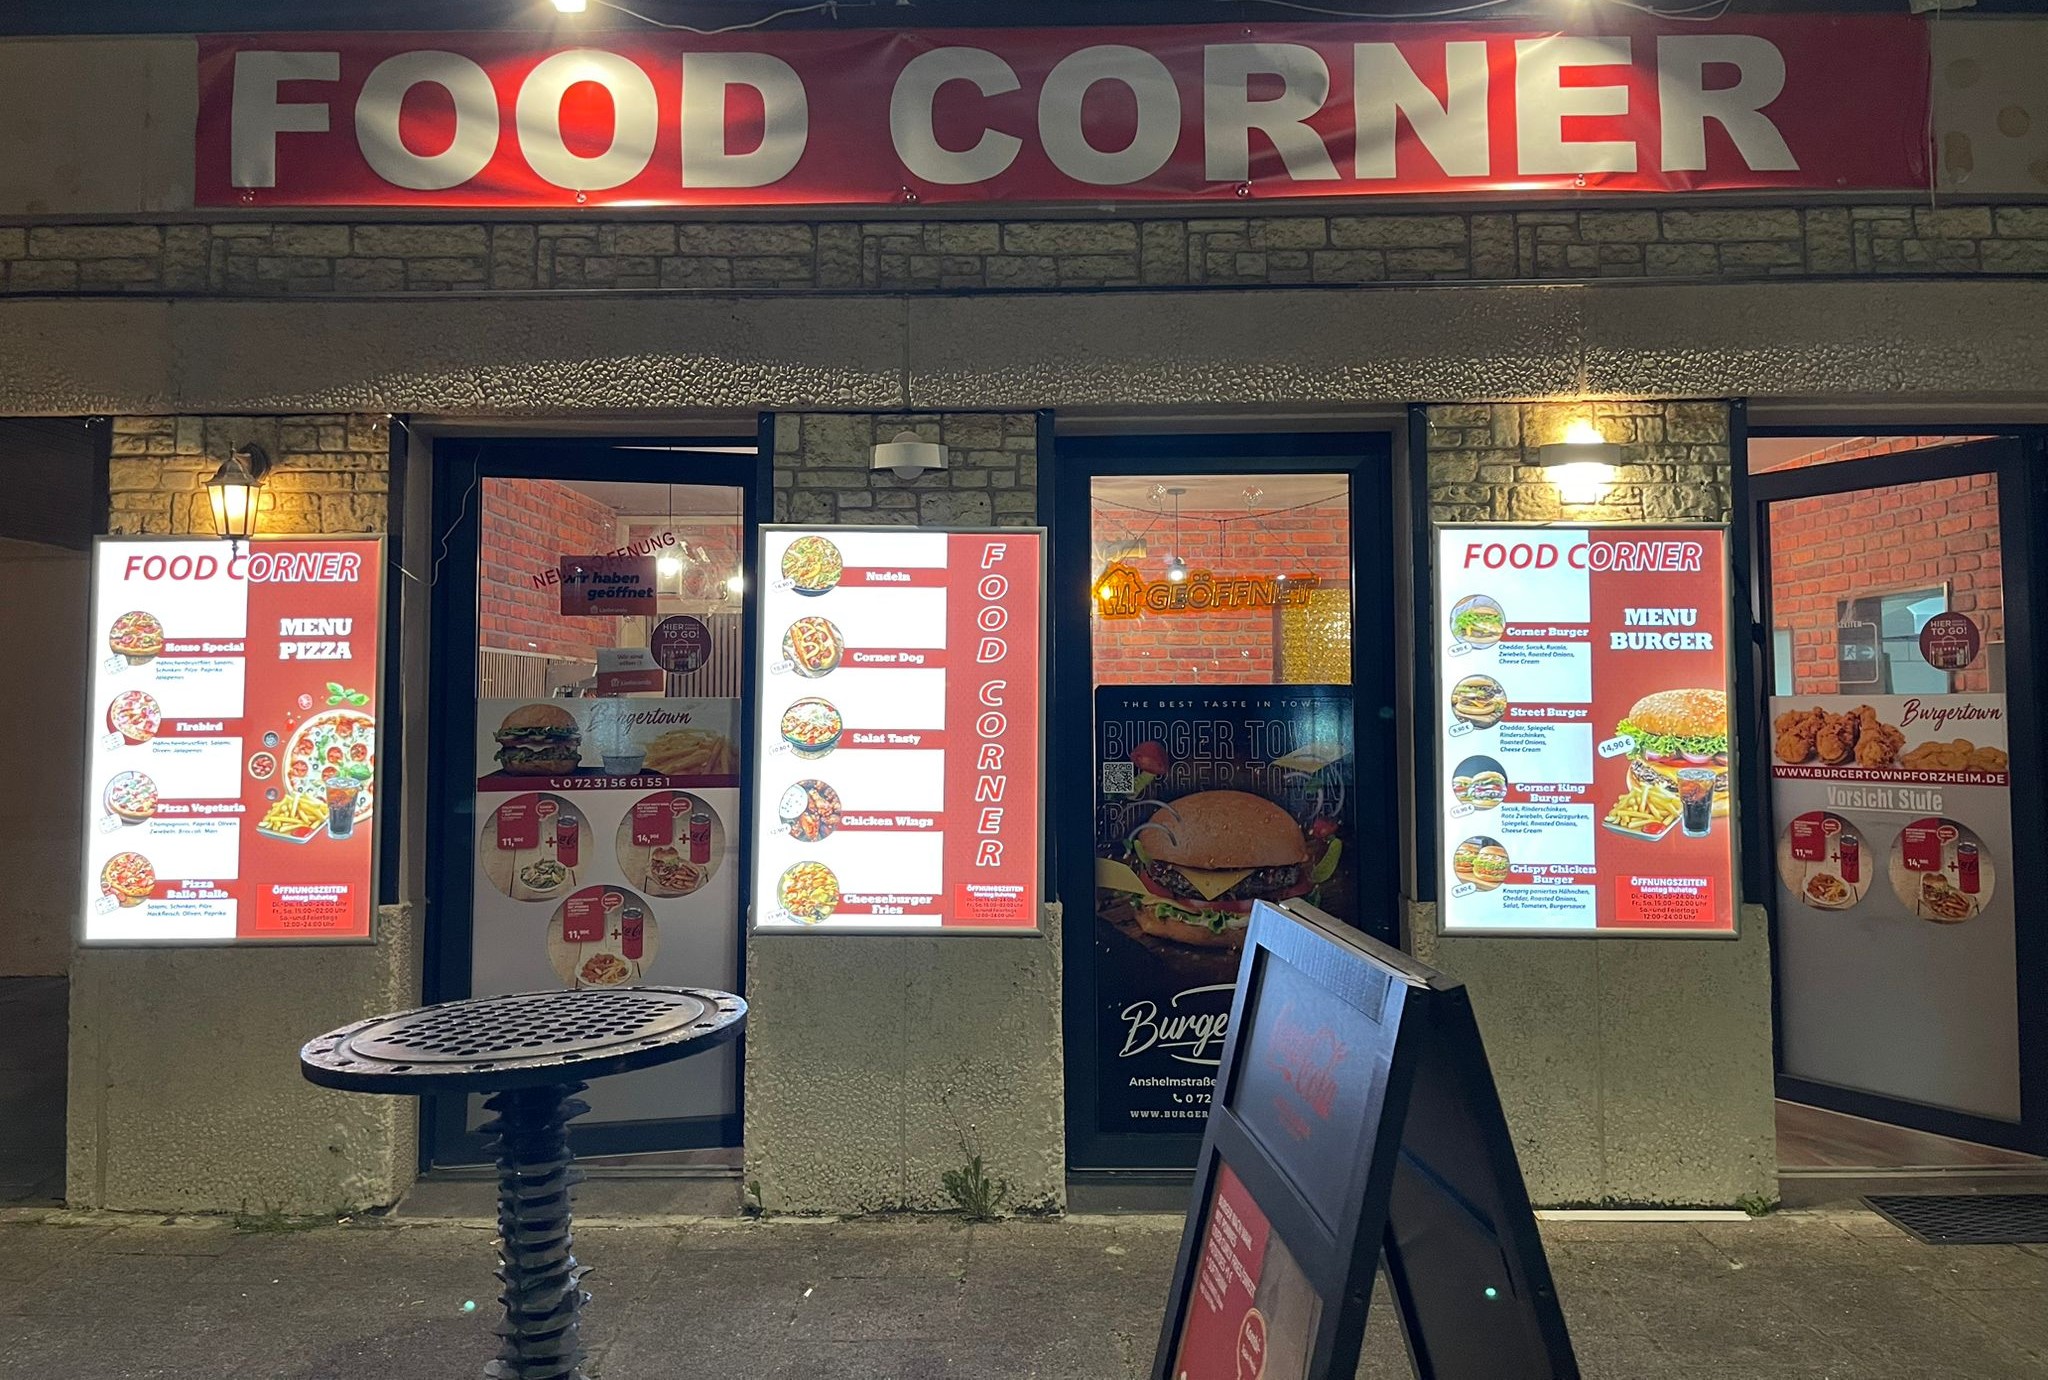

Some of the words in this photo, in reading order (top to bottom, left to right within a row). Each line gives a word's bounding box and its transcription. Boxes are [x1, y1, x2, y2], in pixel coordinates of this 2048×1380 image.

[231, 50, 808, 191] FOOD
[889, 34, 1801, 187] CORNER
[1463, 542, 1559, 570] FOOD
[1567, 541, 1703, 572] CORNER
[124, 555, 218, 581] FOOD
[227, 552, 361, 582] CORNER
[592, 572, 640, 583] haben
[865, 572, 911, 581] Nudeln
[587, 587, 654, 601] geöffnet
[1146, 573, 1315, 610] GEÖFFNET
[976, 542, 1009, 664] FOOD
[1624, 608, 1697, 626] MENU
[279, 617, 352, 636] MENU
[1948, 627, 1967, 635] GO!
[664, 630, 678, 639] TO
[680, 630, 699, 639] GO!
[1506, 627, 1547, 637] Corner
[1548, 627, 1589, 638] Burger
[1610, 632, 1714, 650] BURGER
[165, 643, 200, 652] House
[202, 642, 245, 653] Special
[279, 641, 352, 660] PIZZA
[853, 652, 897, 662] Corner
[899, 653, 925, 664] Dog
[1203, 700, 1247, 708] TASTE
[1257, 700, 1271, 708] IN
[1281, 700, 1321, 708] TOWN
[1510, 707, 1545, 717] Street
[1547, 707, 1588, 718] Burger
[1900, 698, 2003, 731] Burgertown
[176, 721, 224, 731] Firebird
[853, 733, 885, 743] Salat
[887, 733, 921, 746] Tasty
[1103, 720, 1235, 760] BURGER
[1601, 741, 1624, 753] 14,90
[974, 679, 1008, 867] CORNER
[1775, 766, 2005, 784] WWW.BURGERTOWNPFORZHEIM.DE
[563, 779, 572, 788] 0
[575, 779, 591, 788] 72
[594, 778, 607, 788] 31
[610, 778, 627, 788] 56
[630, 778, 643, 787] 61
[646, 777, 662, 787] 55
[665, 777, 670, 787] 1
[1516, 783, 1556, 792] Corner
[1558, 783, 1586, 794] King
[1530, 794, 1571, 804] Burger
[1827, 786, 1893, 809] Vorsicht
[1899, 790, 1943, 811] Stufe
[157, 803, 190, 813] Pizza
[191, 803, 246, 814] Vegetaria
[841, 816, 893, 826] Chicken
[895, 816, 934, 828] Wings
[1510, 864, 1548, 875] Crispy
[1549, 865, 1597, 874] Chicken
[182, 880, 214, 889] Pizza
[1533, 876, 1574, 885] Burger
[1631, 876, 1708, 887] ÖFFNUNGSZEITEN
[272, 885, 348, 894] ÖFFNUNGSZEITEN
[1640, 886, 1668, 894] Montag
[1668, 886, 1698, 895] Ruhetag
[843, 894, 933, 905] Cheeseburger
[871, 905, 904, 915] Fries
[1129, 1077, 1217, 1087] Anshelmstraße
[1185, 1094, 1193, 1103] 0
[1196, 1094, 1211, 1103] 72
[1130, 1110, 1209, 1118] WWW.BURGER
